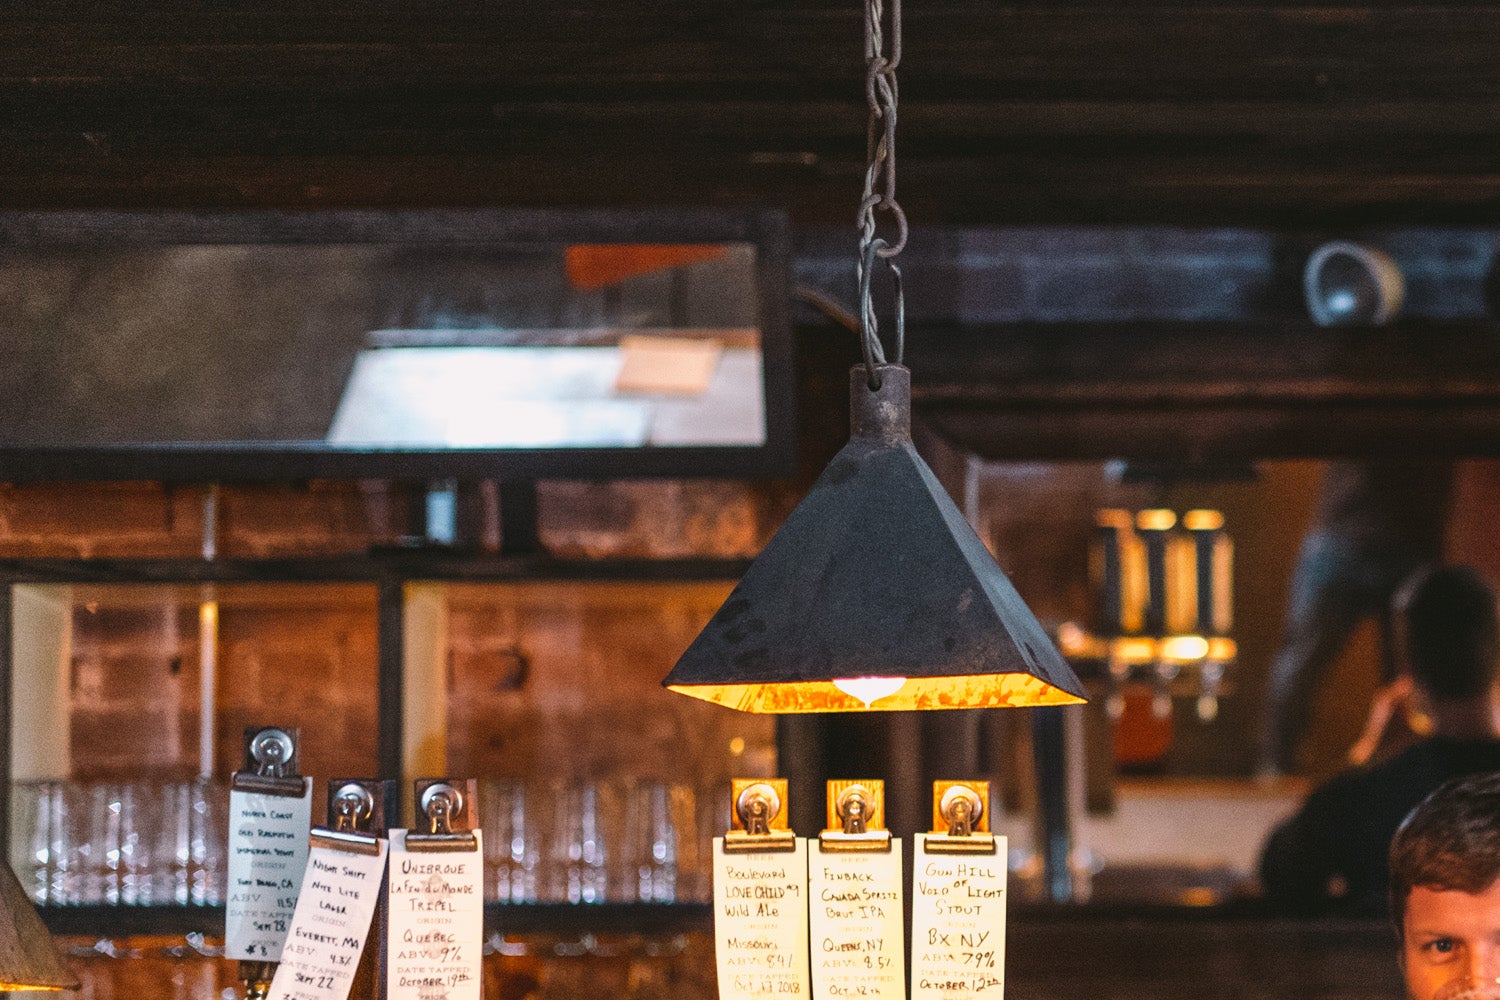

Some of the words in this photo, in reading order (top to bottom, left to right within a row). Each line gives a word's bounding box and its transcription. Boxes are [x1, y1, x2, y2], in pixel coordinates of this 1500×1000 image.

[342, 867, 367, 880] SHIFT
[402, 860, 465, 875] UNIBROUE
[957, 863, 996, 878] HILL
[823, 868, 874, 882] FINBACK
[338, 886, 360, 900] LITE
[725, 887, 752, 899] LOVE
[755, 886, 785, 899] CHILD
[919, 881, 949, 895] VOID
[954, 880, 967, 888] OF
[410, 899, 456, 912] TRIPEL
[859, 906, 886, 918] IPA
[936, 900, 982, 915] STOUT
[403, 929, 456, 943] QUEBEC
[928, 928, 950, 947] BX
[961, 931, 989, 947] NY
[318, 977, 334, 989] 22
[400, 977, 445, 987] OCTOBER
[920, 978, 969, 990] OCTOBER
